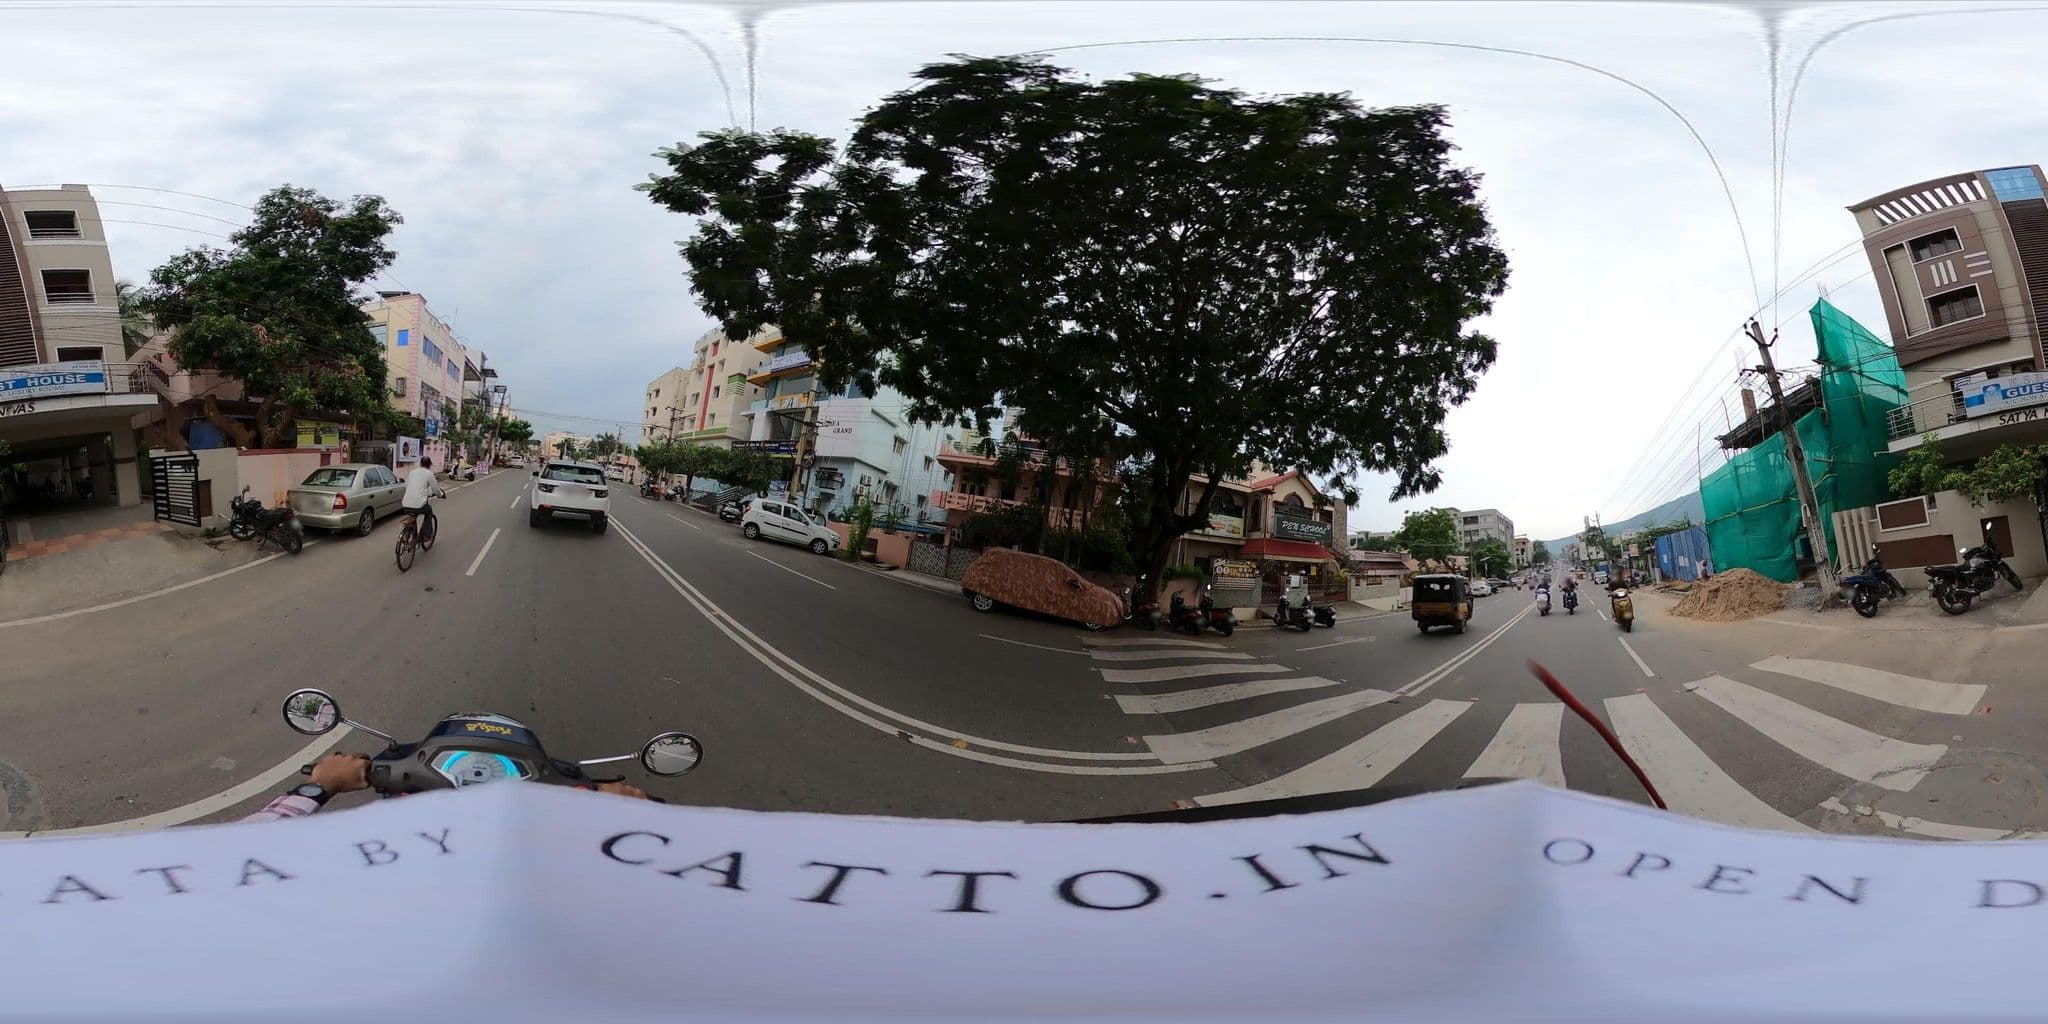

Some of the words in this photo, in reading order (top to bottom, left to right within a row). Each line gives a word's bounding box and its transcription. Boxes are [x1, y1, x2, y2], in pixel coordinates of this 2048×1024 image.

[27, 374, 86, 387] HOUSE
[39, 385, 65, 393] ROOMS
[2000, 409, 2037, 425] SATYA
[1282, 521, 1299, 530] PEN
[1300, 524, 1326, 534] SCHOOL
[40, 857, 296, 904] ATA
[354, 828, 453, 867] BY
[600, 831, 1392, 914] CATTO.IN
[1543, 837, 1866, 905] OPEN
